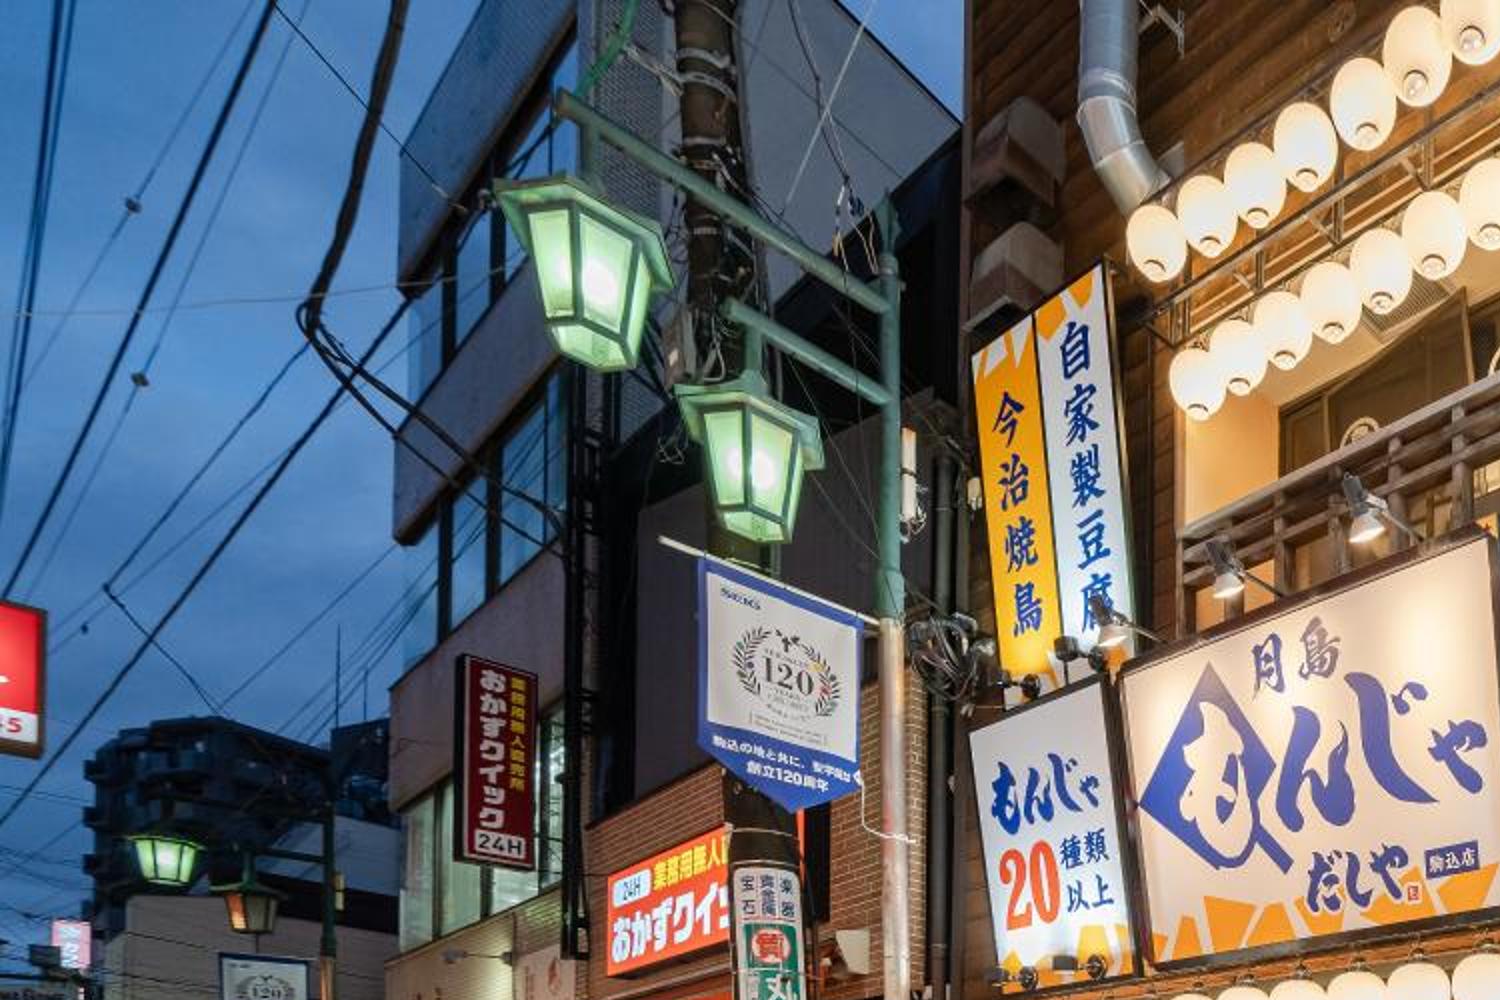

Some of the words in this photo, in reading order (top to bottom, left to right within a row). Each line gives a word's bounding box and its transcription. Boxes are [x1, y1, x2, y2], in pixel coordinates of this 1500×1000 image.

[991, 390, 1043, 637] 今治焼鳥
[1060, 321, 1114, 633] 自家製豆腐
[764, 657, 815, 697] 120
[1250, 615, 1342, 700] 月島
[479, 669, 507, 829] おかずクイック
[1145, 670, 1489, 874] もんじゃ
[990, 752, 1100, 834] もんじゃ
[478, 834, 522, 856] 24H
[999, 840, 1060, 931] 20
[1059, 828, 1110, 869] 種類
[1307, 842, 1408, 914] だしや
[1066, 874, 1115, 913] 以上
